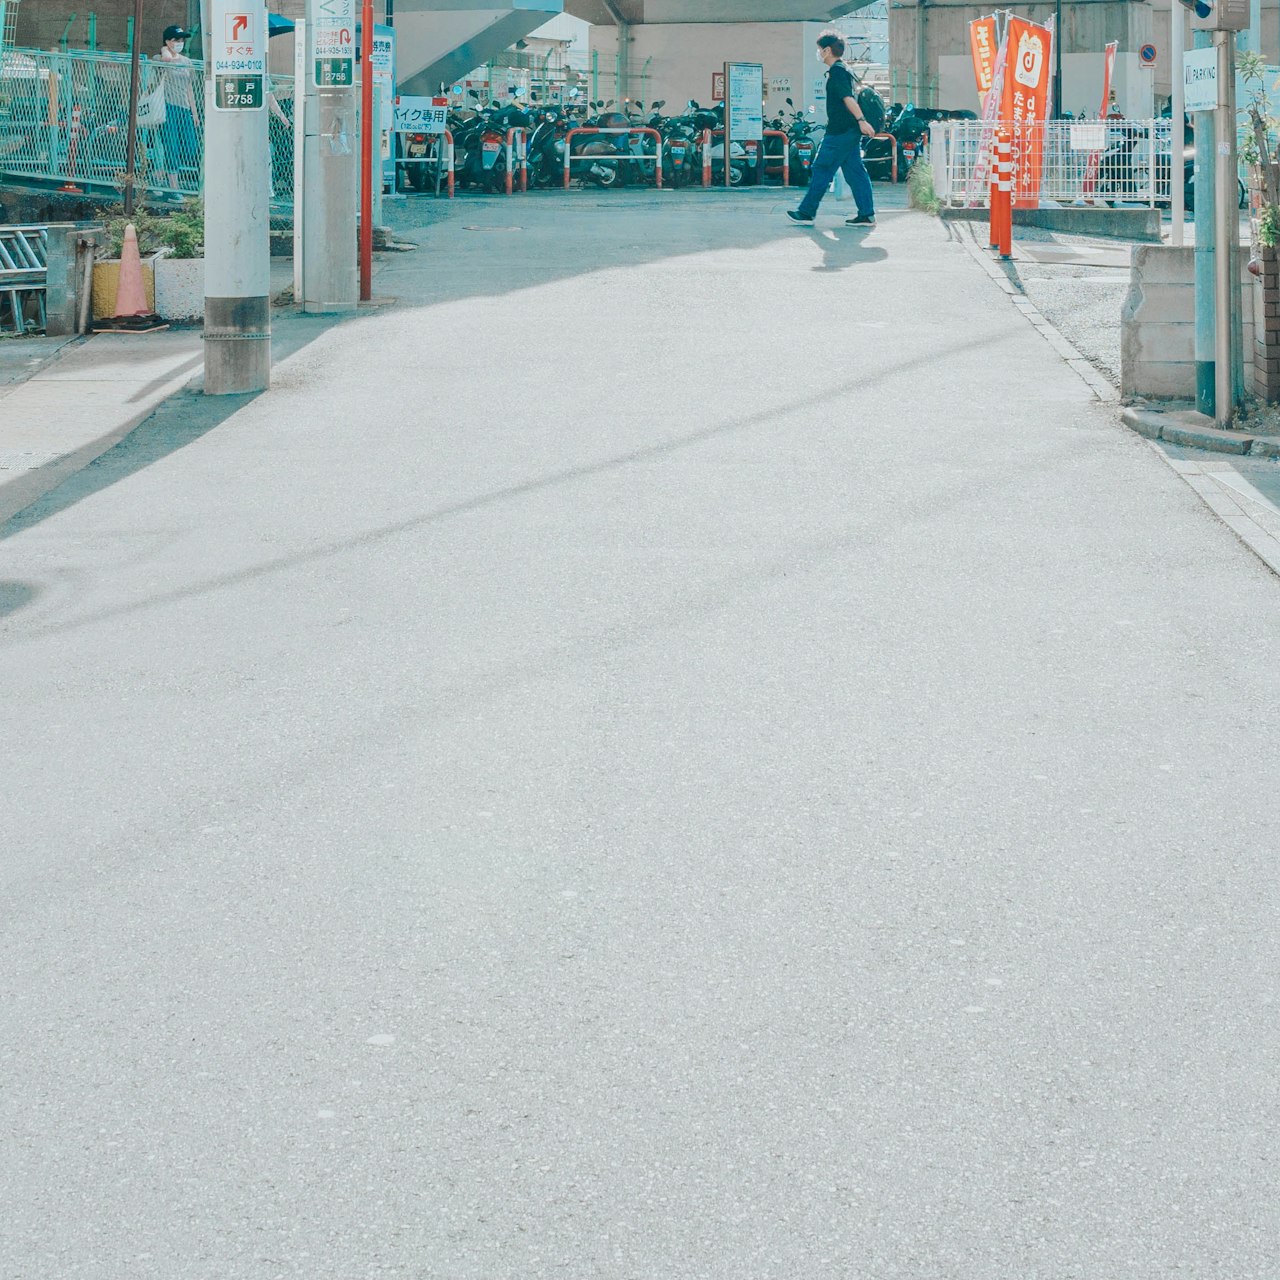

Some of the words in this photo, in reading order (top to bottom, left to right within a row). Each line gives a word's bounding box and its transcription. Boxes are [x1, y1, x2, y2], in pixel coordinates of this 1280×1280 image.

[225, 46, 255, 56] すぐ先
[215, 60, 263, 70] 044-934-0102
[224, 82, 256, 93] 登戸
[227, 94, 254, 105] 2758
